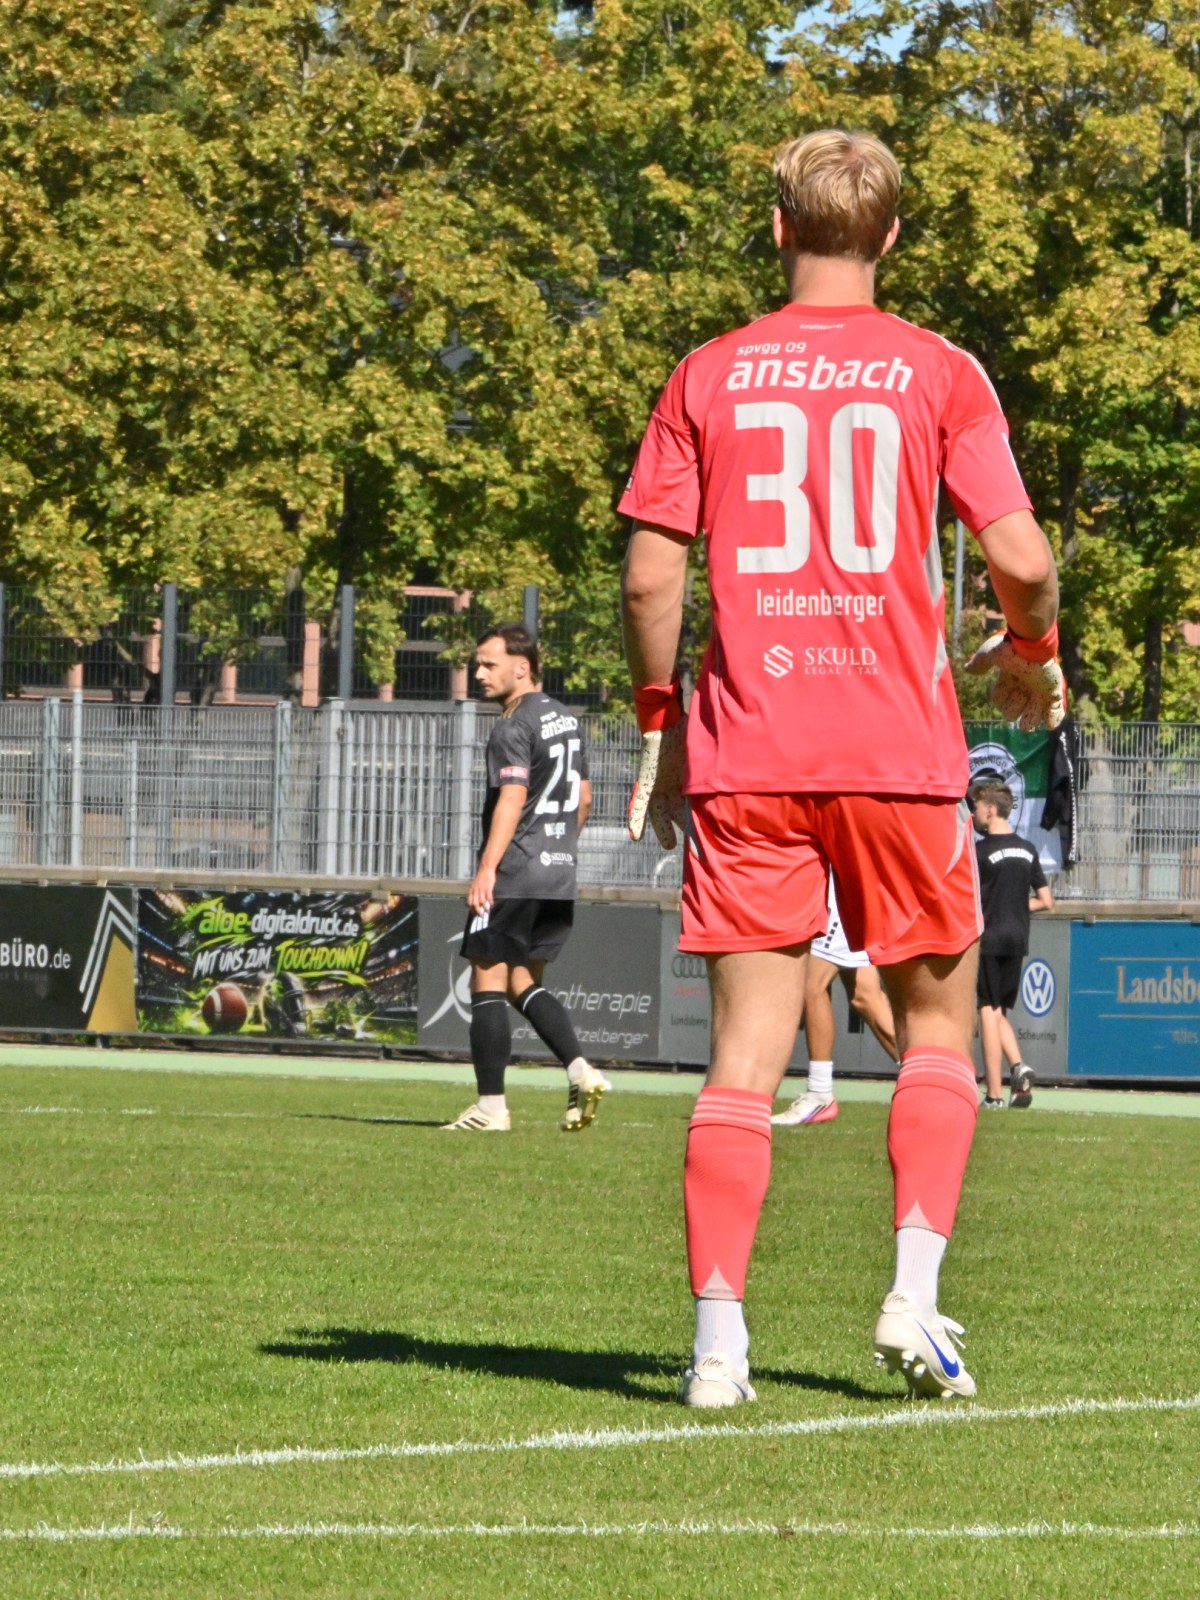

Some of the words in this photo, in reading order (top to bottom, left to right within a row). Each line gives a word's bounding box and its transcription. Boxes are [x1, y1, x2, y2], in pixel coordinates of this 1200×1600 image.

[736, 343, 781, 356] spvgg
[785, 341, 807, 353] 09
[727, 355, 913, 393] ansbach
[734, 401, 900, 574] 30
[757, 588, 886, 622] leidenberger
[804, 647, 877, 666] SKULD
[804, 667, 840, 675] LEGAL
[857, 667, 879, 675] TAX
[534, 738, 581, 815] 25
[199, 902, 360, 940] aloe-digitaldruck.de
[192, 949, 220, 980] MIT
[219, 947, 246, 974] UNS
[275, 939, 368, 976] TOUCHDOWN!
[1017, 1028, 1057, 1045] Scheuring
